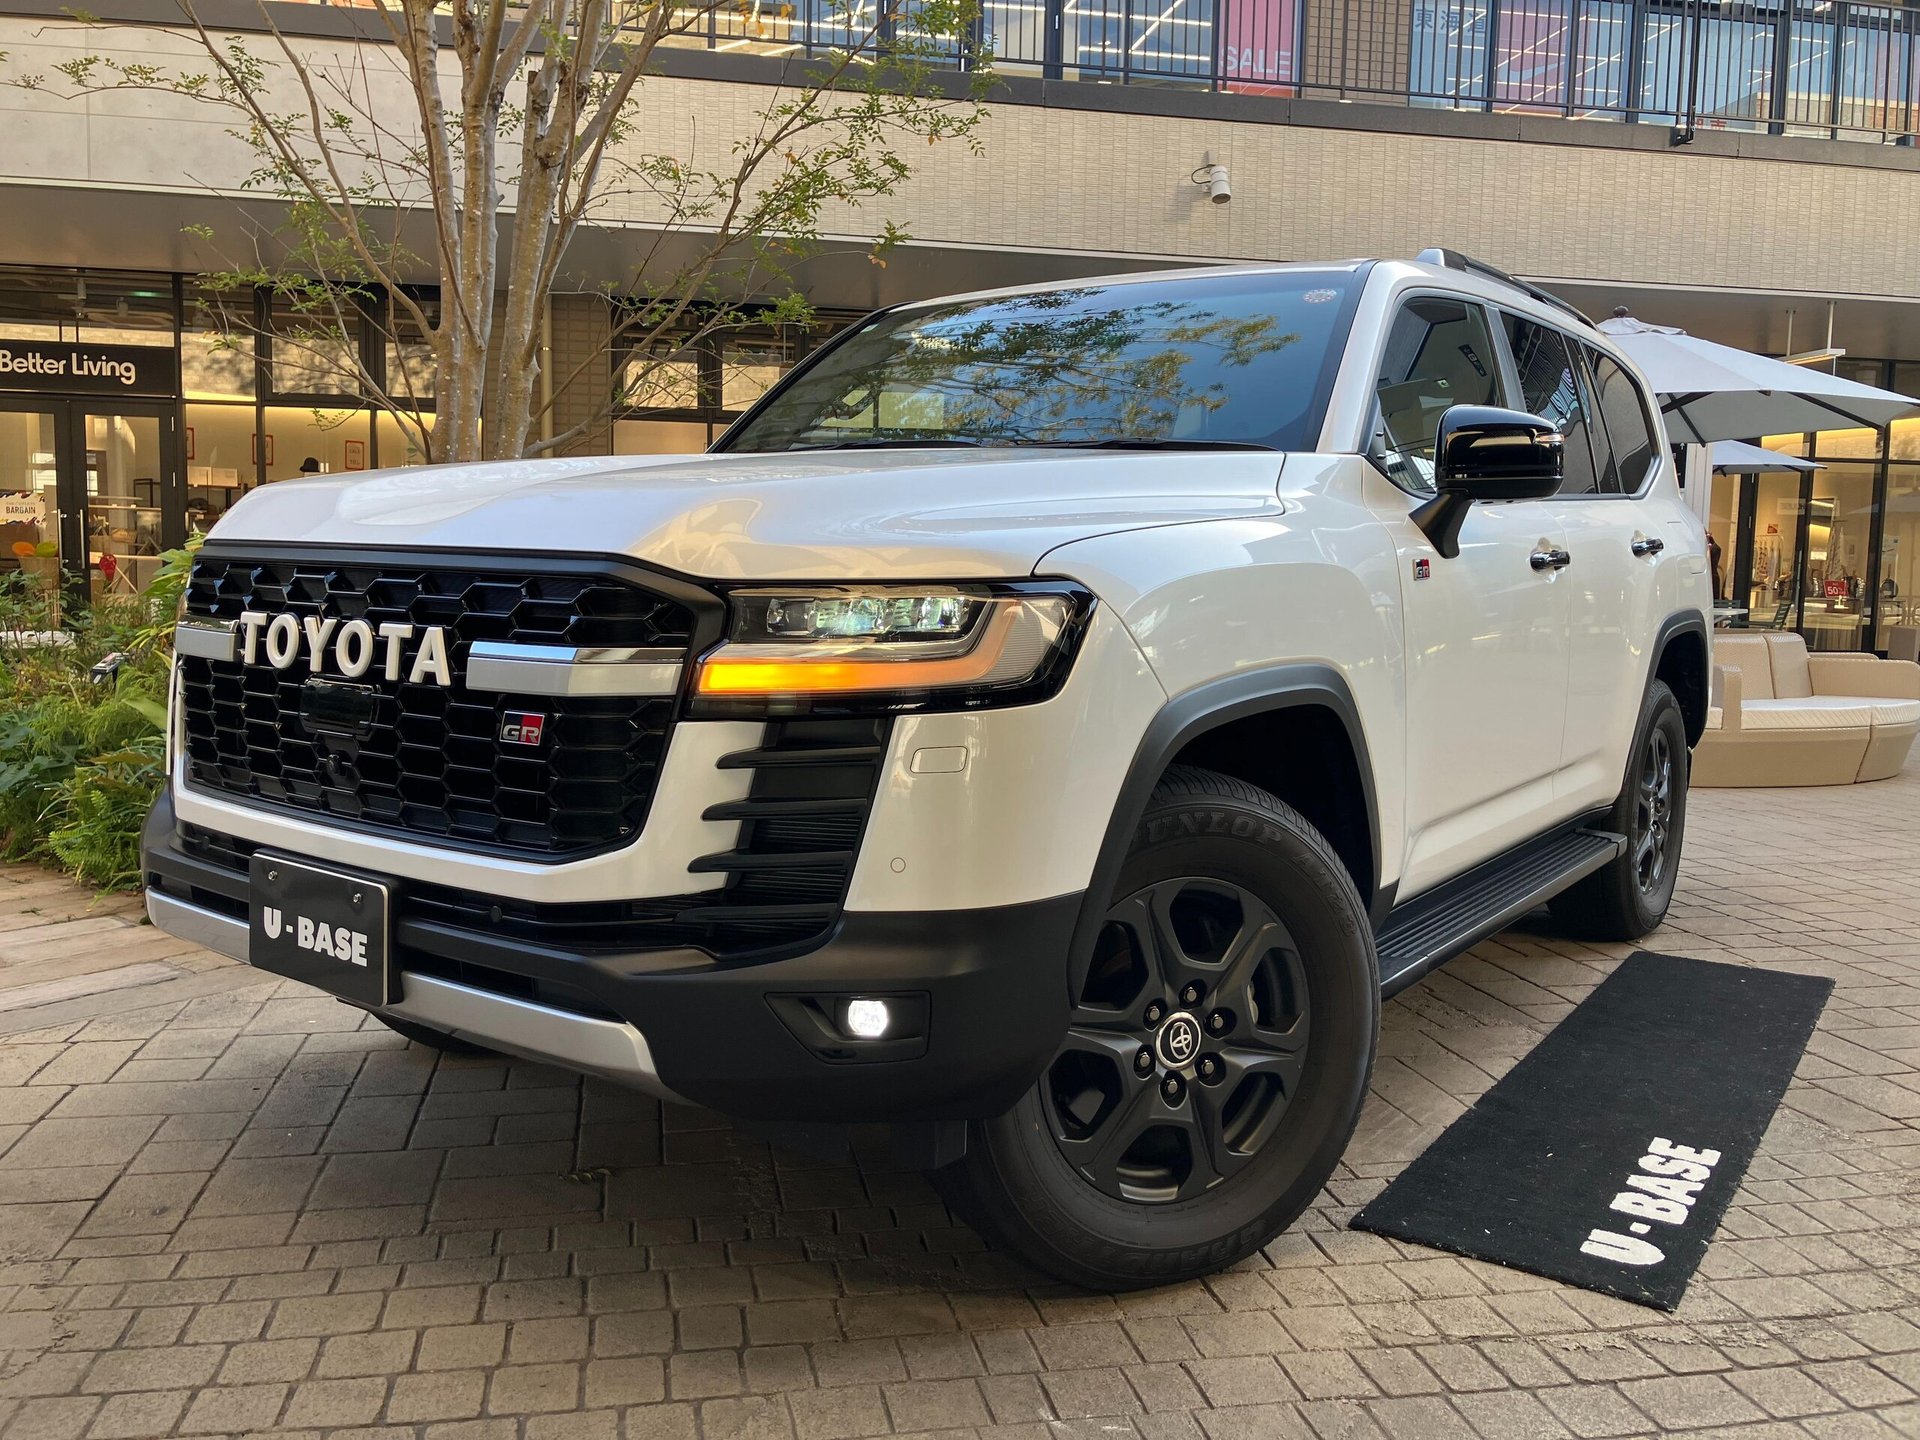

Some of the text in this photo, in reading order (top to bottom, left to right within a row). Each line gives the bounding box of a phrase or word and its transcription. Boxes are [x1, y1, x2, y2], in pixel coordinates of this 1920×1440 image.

[1220, 45, 1291, 75] SALE
[0, 349, 136, 385] Better Living
[5, 506, 36, 514] BARGAIN
[240, 611, 451, 686] TOYOTA
[502, 724, 540, 743] GR
[1140, 812, 1283, 843] UNLOP
[263, 905, 368, 967] U-BASE
[1579, 1136, 1722, 1266] U-BASE
